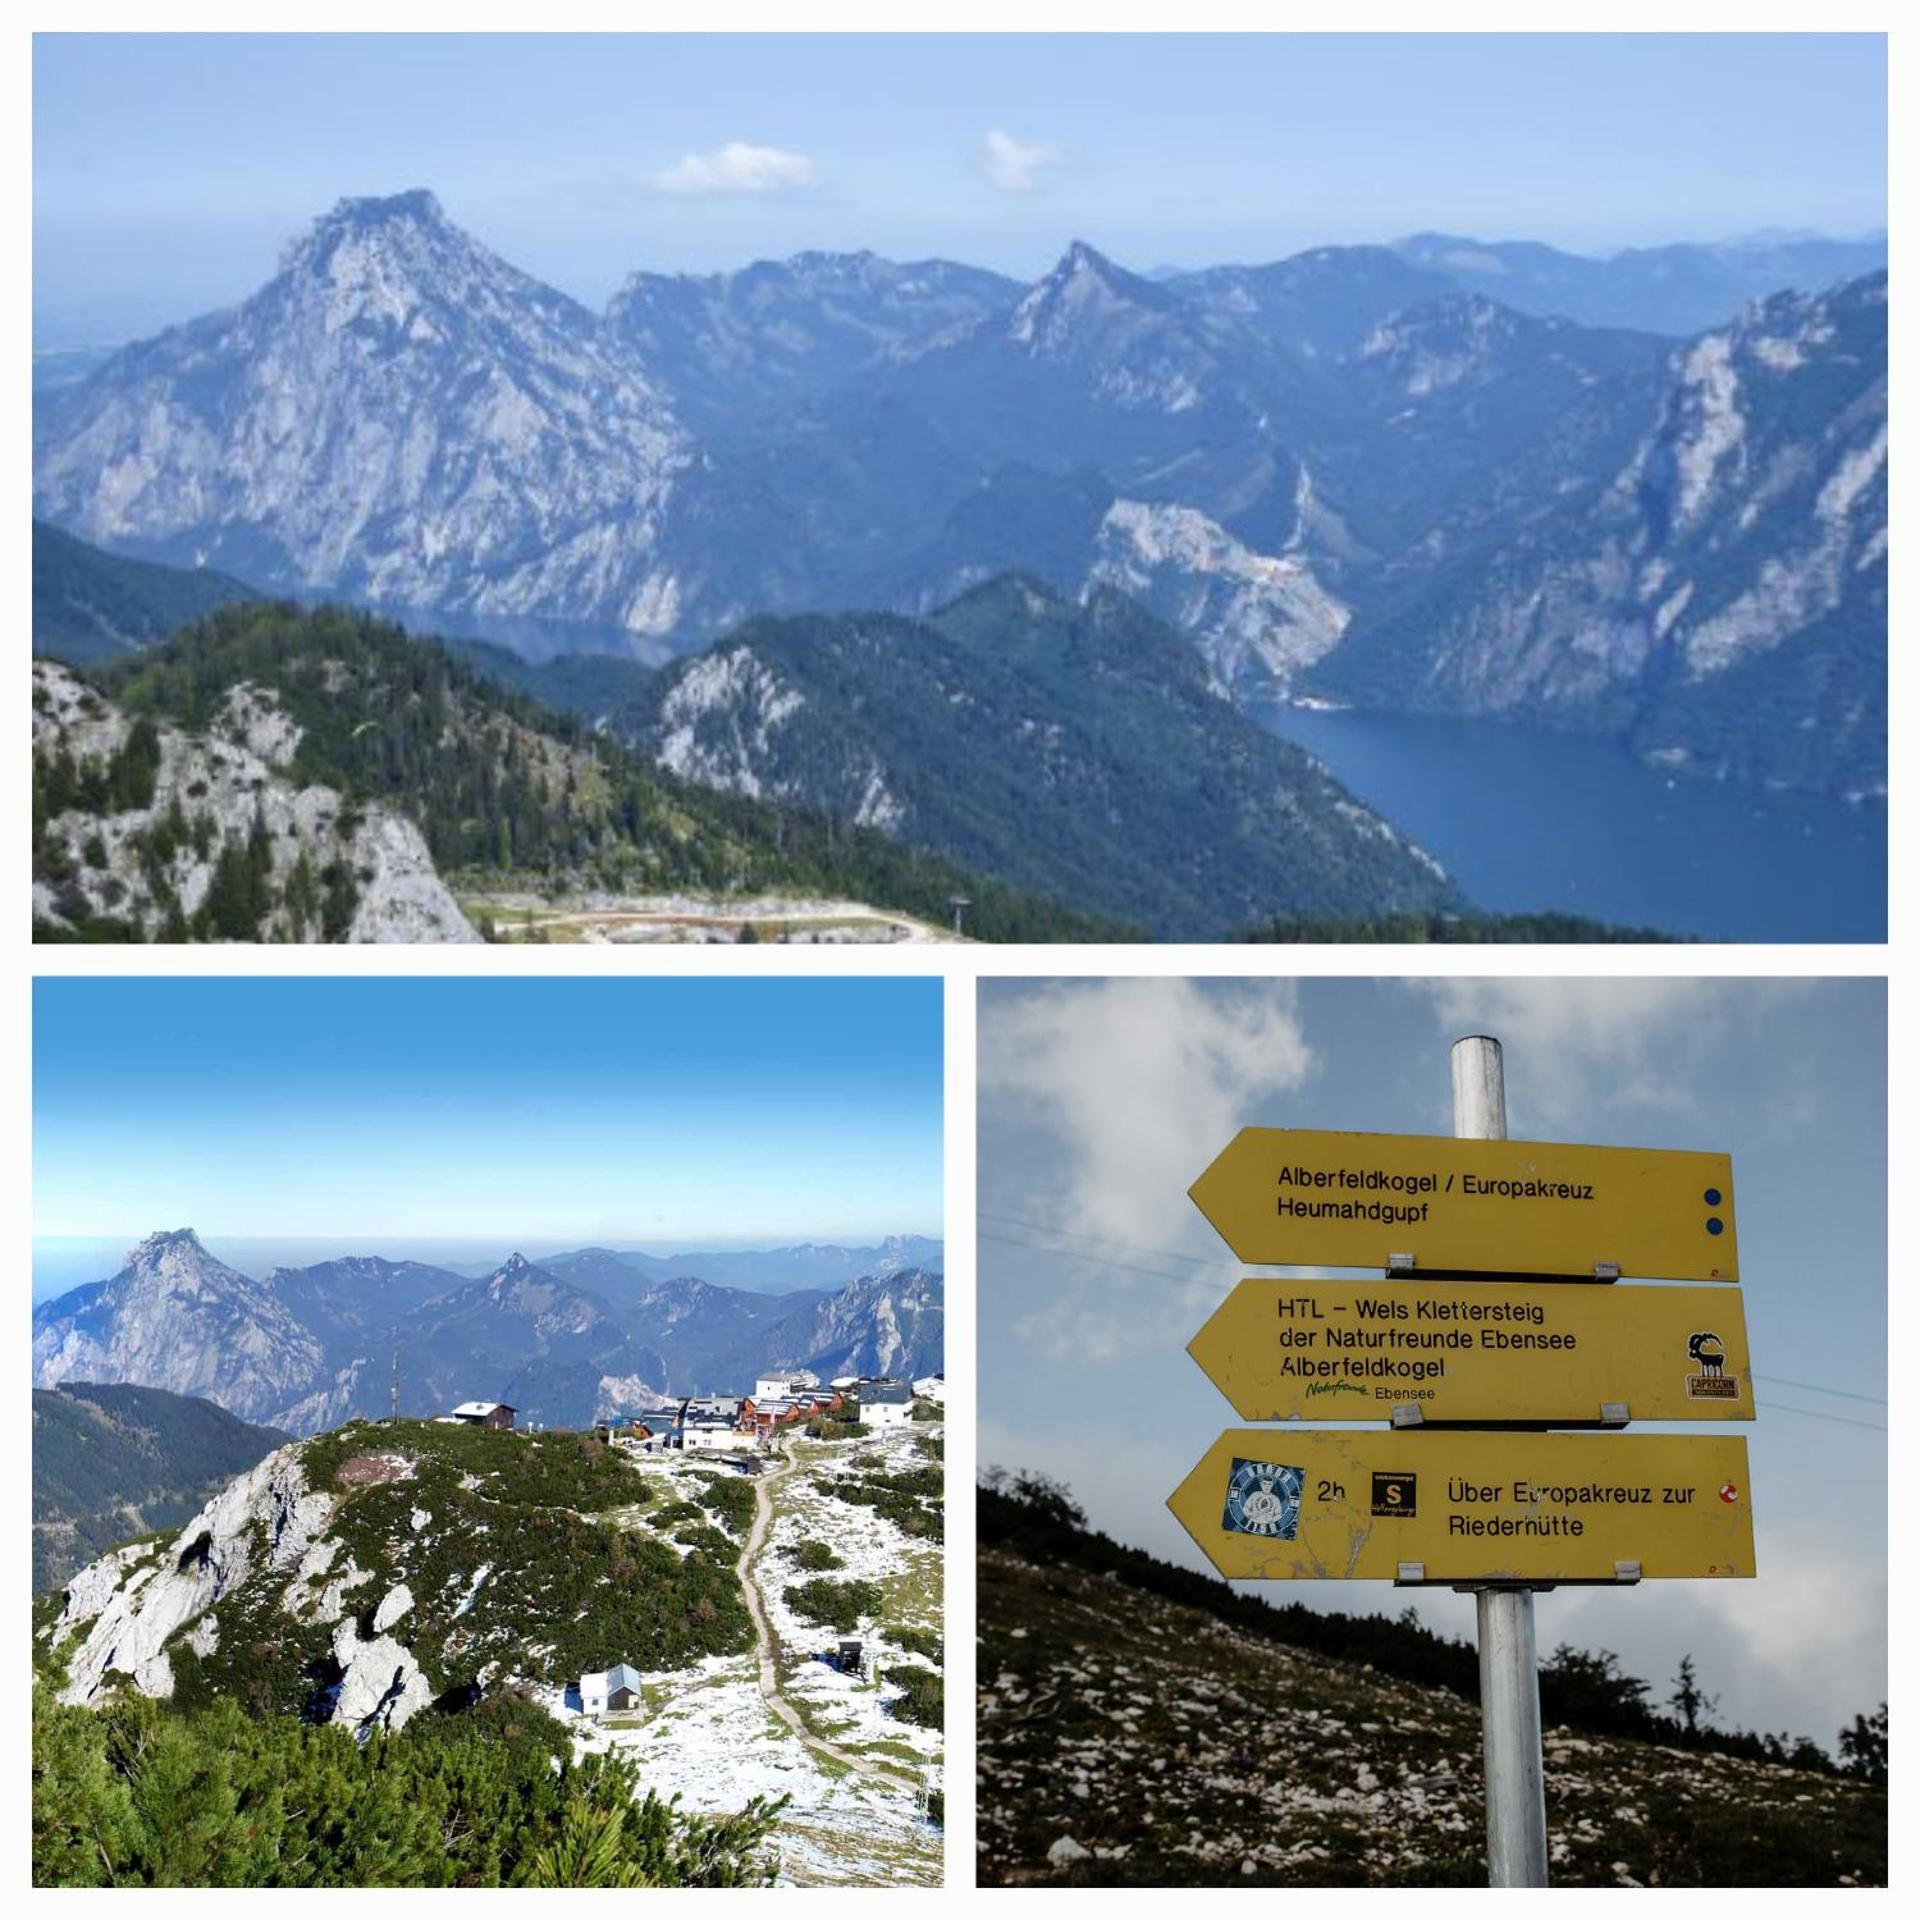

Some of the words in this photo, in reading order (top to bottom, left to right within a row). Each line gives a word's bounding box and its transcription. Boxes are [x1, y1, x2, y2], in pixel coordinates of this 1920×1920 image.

[1279, 1167, 1436, 1194] Alberfeldkogel
[1446, 1175, 1453, 1192] /
[1463, 1175, 1594, 1199] Europakreuz
[1278, 1198, 1428, 1224] Heumahdgupf
[1279, 1299, 1324, 1318] HTL
[1356, 1300, 1408, 1319] Wels
[1417, 1301, 1544, 1324] Klettersteig
[1280, 1328, 1317, 1347] der
[1327, 1328, 1472, 1348] Naturfreunde
[1481, 1330, 1575, 1349] Ebensee
[1281, 1357, 1444, 1381] Alberfeldkogel
[1376, 1388, 1434, 1399] Ebensee
[1691, 1378, 1735, 1390] CAPRICORN
[1318, 1481, 1345, 1501] 2h
[1386, 1484, 1402, 1504] S
[1449, 1478, 1503, 1502] Über
[1514, 1482, 1652, 1506] Europakreuz
[1663, 1489, 1695, 1503] zur
[1450, 1516, 1583, 1536] Riederhütte
